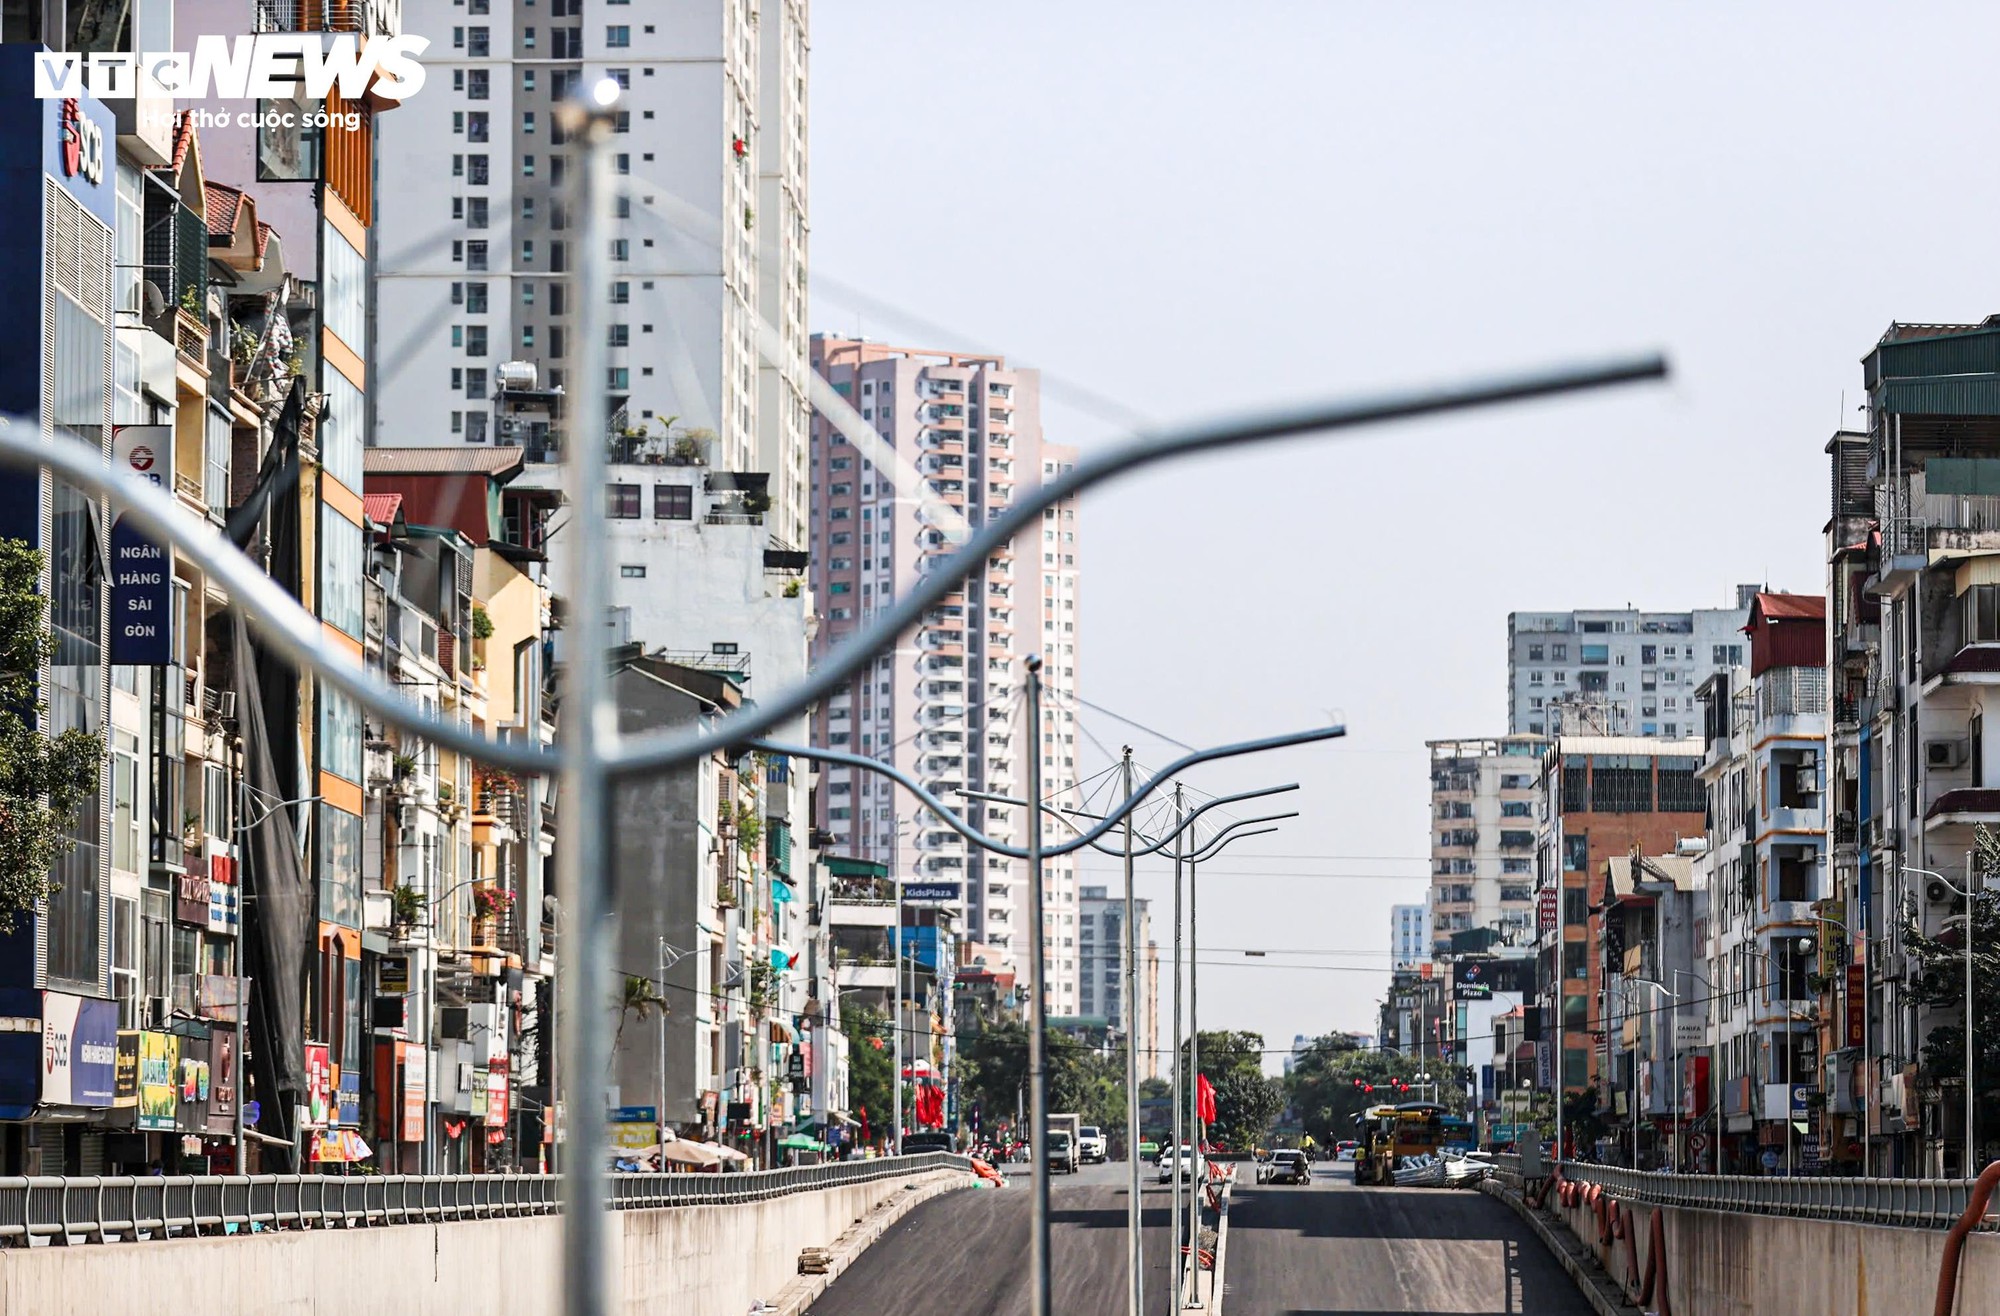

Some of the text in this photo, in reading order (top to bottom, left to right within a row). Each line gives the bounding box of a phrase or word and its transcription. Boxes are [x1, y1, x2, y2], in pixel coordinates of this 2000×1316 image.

[79, 110, 103, 185] SCB
[120, 544, 161, 559] NGÂN
[120, 570, 161, 585] HÀNG
[128, 596, 152, 611] SÀI
[124, 622, 155, 637] GÒN
[906, 888, 952, 897] KidsPlaza
[1462, 989, 1483, 997] Pizza
[1852, 1024, 1861, 1039] 6
